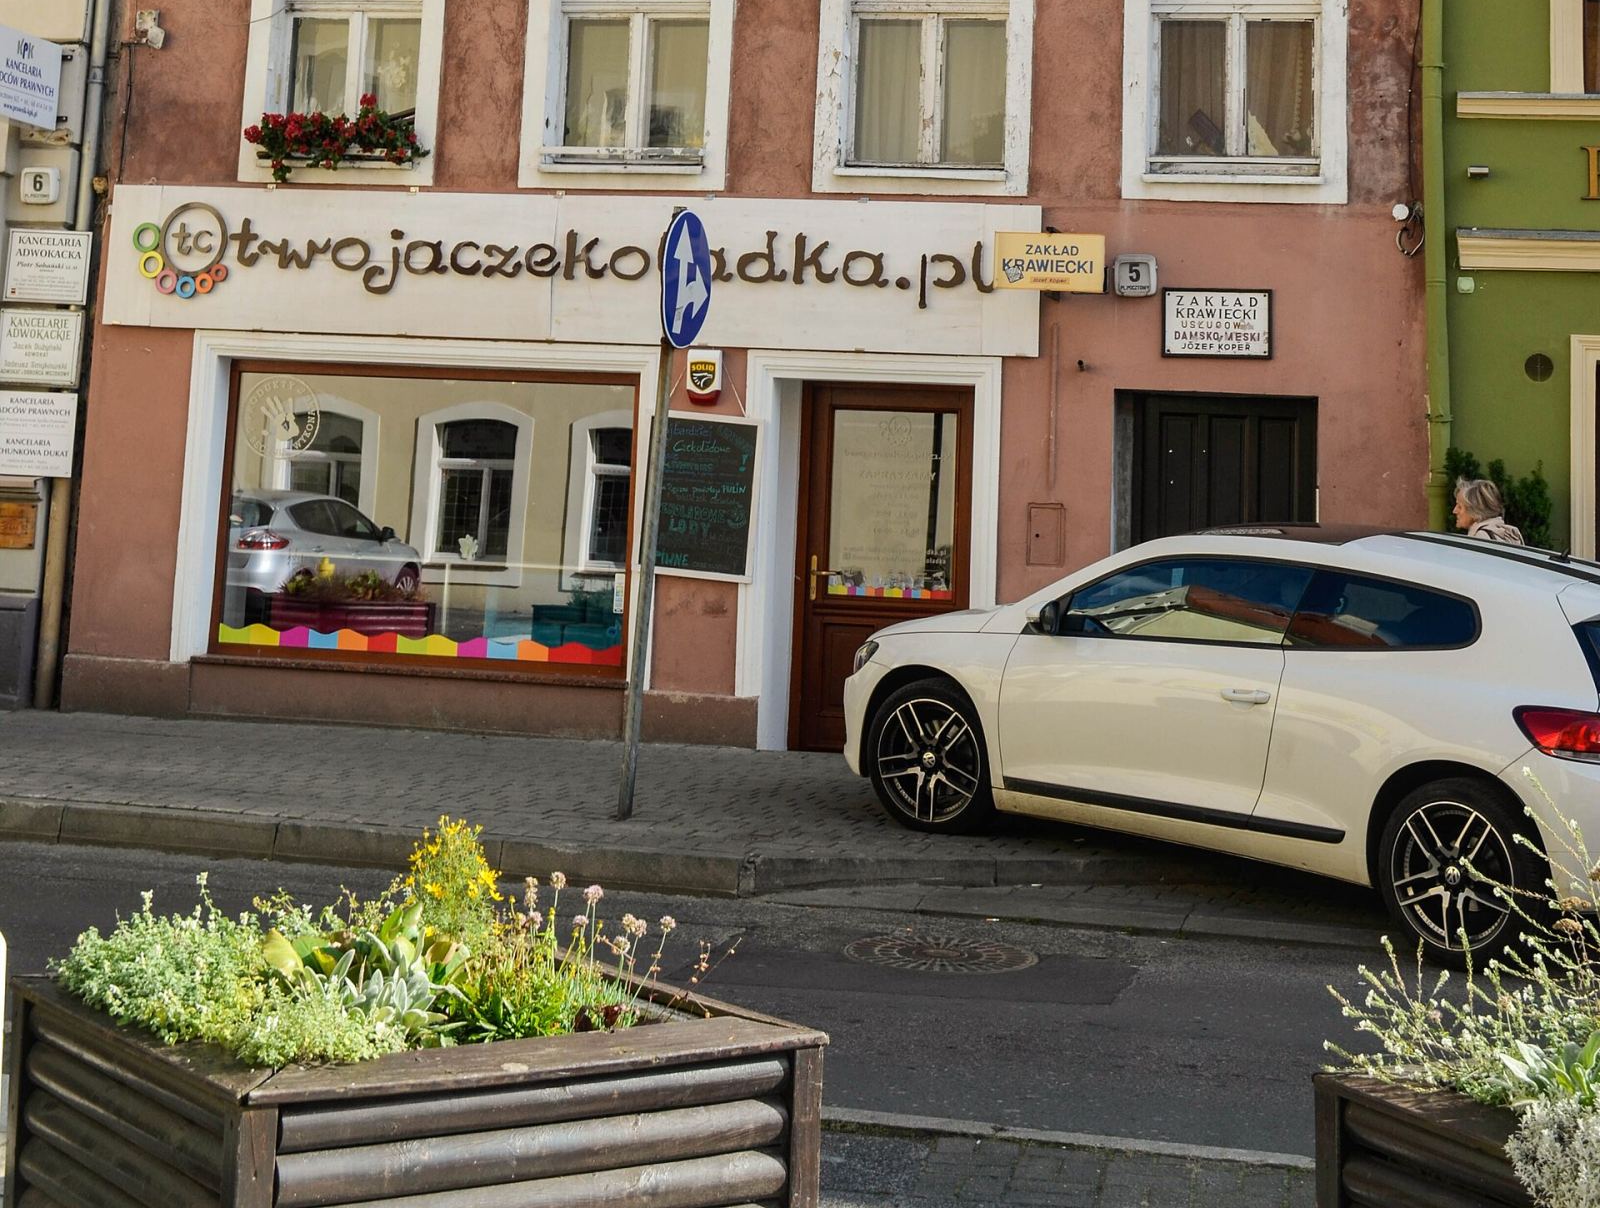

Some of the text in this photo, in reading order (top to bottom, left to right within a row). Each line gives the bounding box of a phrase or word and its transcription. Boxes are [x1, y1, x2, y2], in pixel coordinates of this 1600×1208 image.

[17, 38, 35, 59] KPK
[5, 58, 42, 79] KANCELARIA
[0, 70, 54, 97] DCÓW PRAWNYCH
[33, 173, 44, 192] 6
[18, 236, 82, 248] KANCELARIA
[16, 248, 82, 260] ADWOKACKA
[1025, 244, 1079, 256] ZAKŁAD
[229, 217, 996, 309] twojaczekoadka.pl
[1002, 258, 1094, 274] KRAWIECKI
[1128, 263, 1141, 282] 5
[1176, 295, 1258, 307] ZAKŁAD
[1176, 307, 1257, 320] KRAWIECKI
[10, 316, 69, 329] KANCELARIE
[6, 328, 71, 342] ADWOKACKIE
[1181, 341, 1251, 351] JÓZEF KOPER
[691, 363, 714, 371] SOLID
[9, 397, 55, 405] KANCELARIA
[0, 406, 71, 416] DCÓW PRAWNYCH
[6, 438, 51, 447] KANCELARIA
[0, 447, 69, 457] HUNKOWA DUKAT
